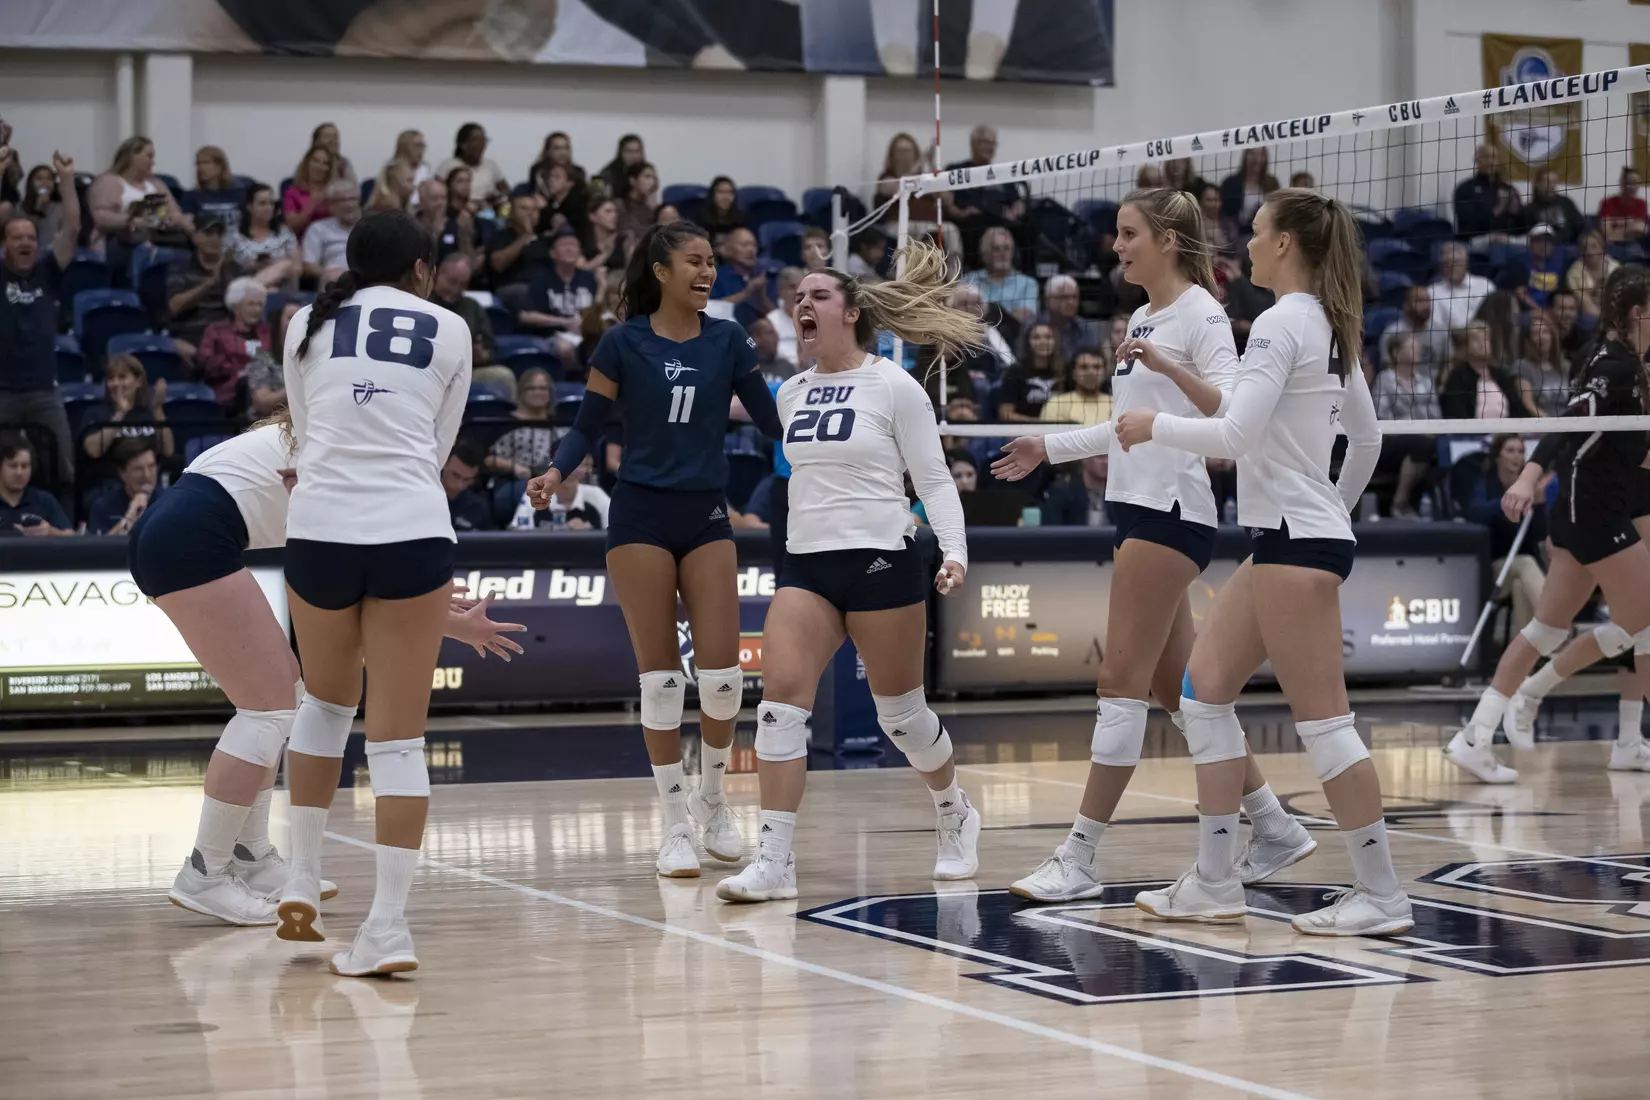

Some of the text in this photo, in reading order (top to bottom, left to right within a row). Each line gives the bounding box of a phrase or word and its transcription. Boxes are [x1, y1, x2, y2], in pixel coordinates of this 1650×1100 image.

[1482, 70, 1618, 109] #LANCEUP
[1388, 101, 1421, 122] CBU
[1222, 115, 1331, 146] #LANCEUP
[1146, 140, 1172, 157] CBU
[949, 168, 971, 185] CBU
[1011, 150, 1099, 177] #LANCEUP
[326, 305, 439, 369] 18
[668, 386, 695, 423] 11
[806, 386, 856, 405] CBU
[786, 408, 856, 444] 20
[737, 567, 776, 596] de
[866, 563, 893, 574] adidas
[0, 580, 150, 608] SAVAG
[548, 570, 605, 606] by
[981, 584, 1030, 600] ENJOY
[981, 600, 1030, 618] FREE
[1408, 598, 1460, 624] CBU
[8, 685, 27, 694] SAN
[432, 667, 463, 689] BU
